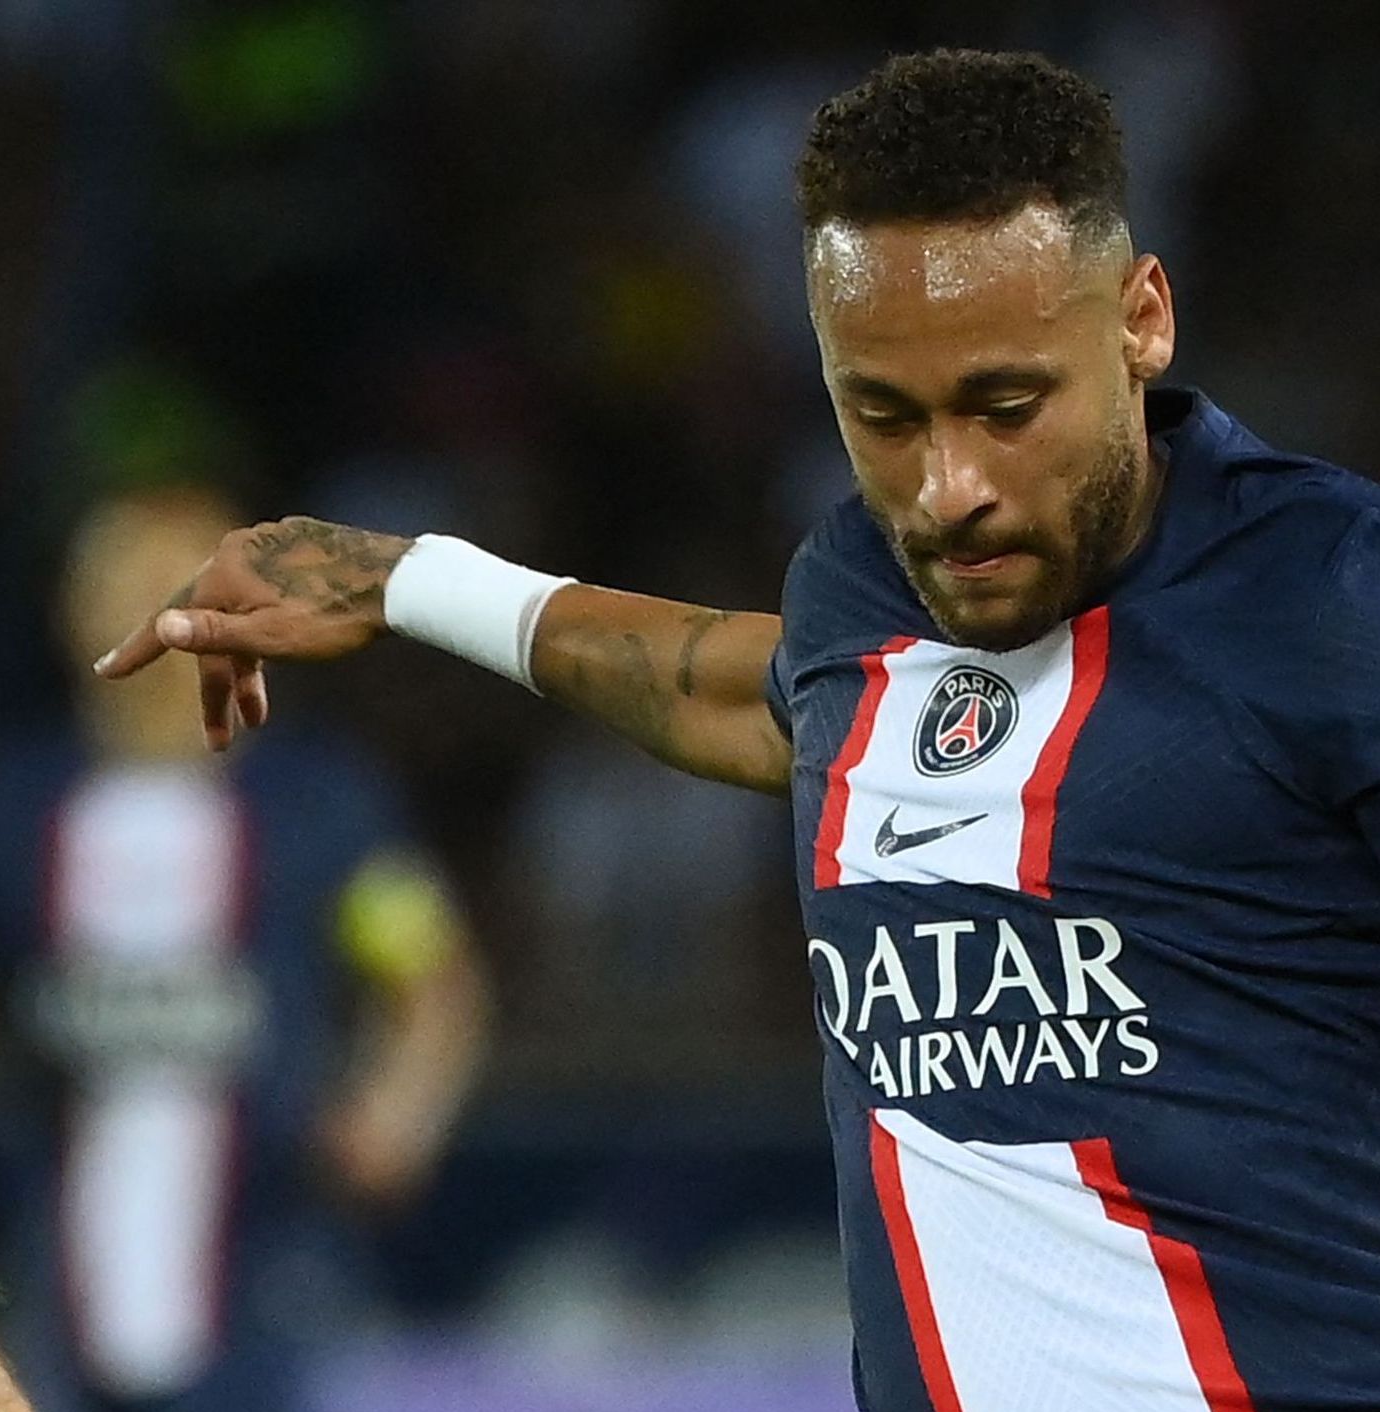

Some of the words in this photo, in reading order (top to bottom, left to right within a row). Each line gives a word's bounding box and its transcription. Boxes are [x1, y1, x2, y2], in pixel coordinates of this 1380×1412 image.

[944, 674, 1007, 709] PARIS
[807, 917, 1147, 1061] QATAR
[869, 1014, 1160, 1099] AIRWAYS
